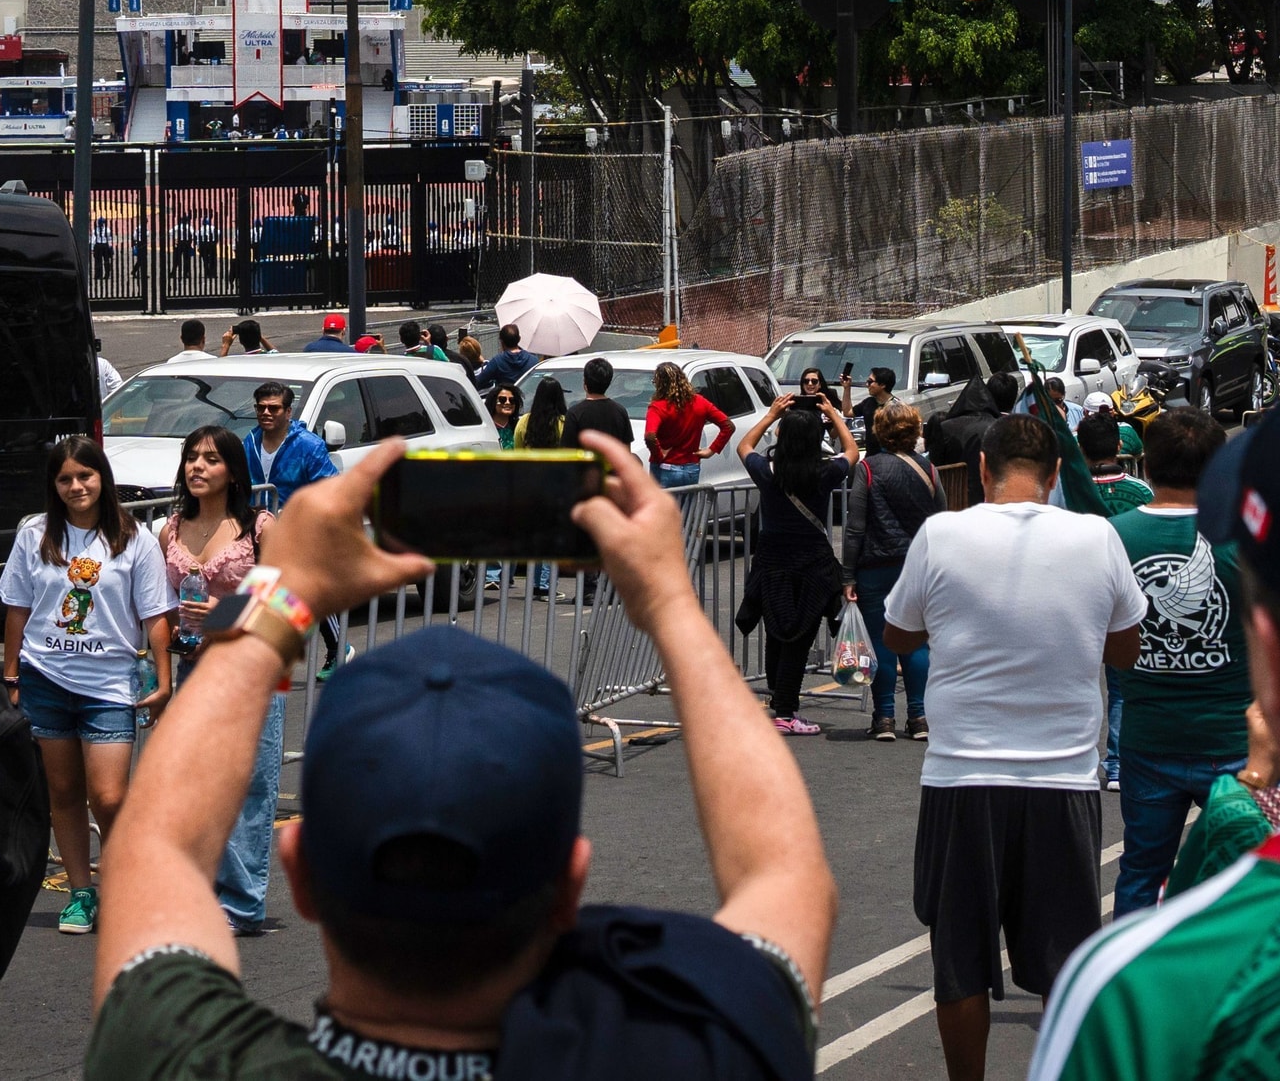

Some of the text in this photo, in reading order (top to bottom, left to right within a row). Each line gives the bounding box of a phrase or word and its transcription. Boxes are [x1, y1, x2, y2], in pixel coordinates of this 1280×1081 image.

[244, 39, 273, 47] ULTRA
[45, 636, 105, 654] SABINA
[1136, 649, 1226, 669] MÉXICO
[328, 1034, 492, 1081] ARMOUR
